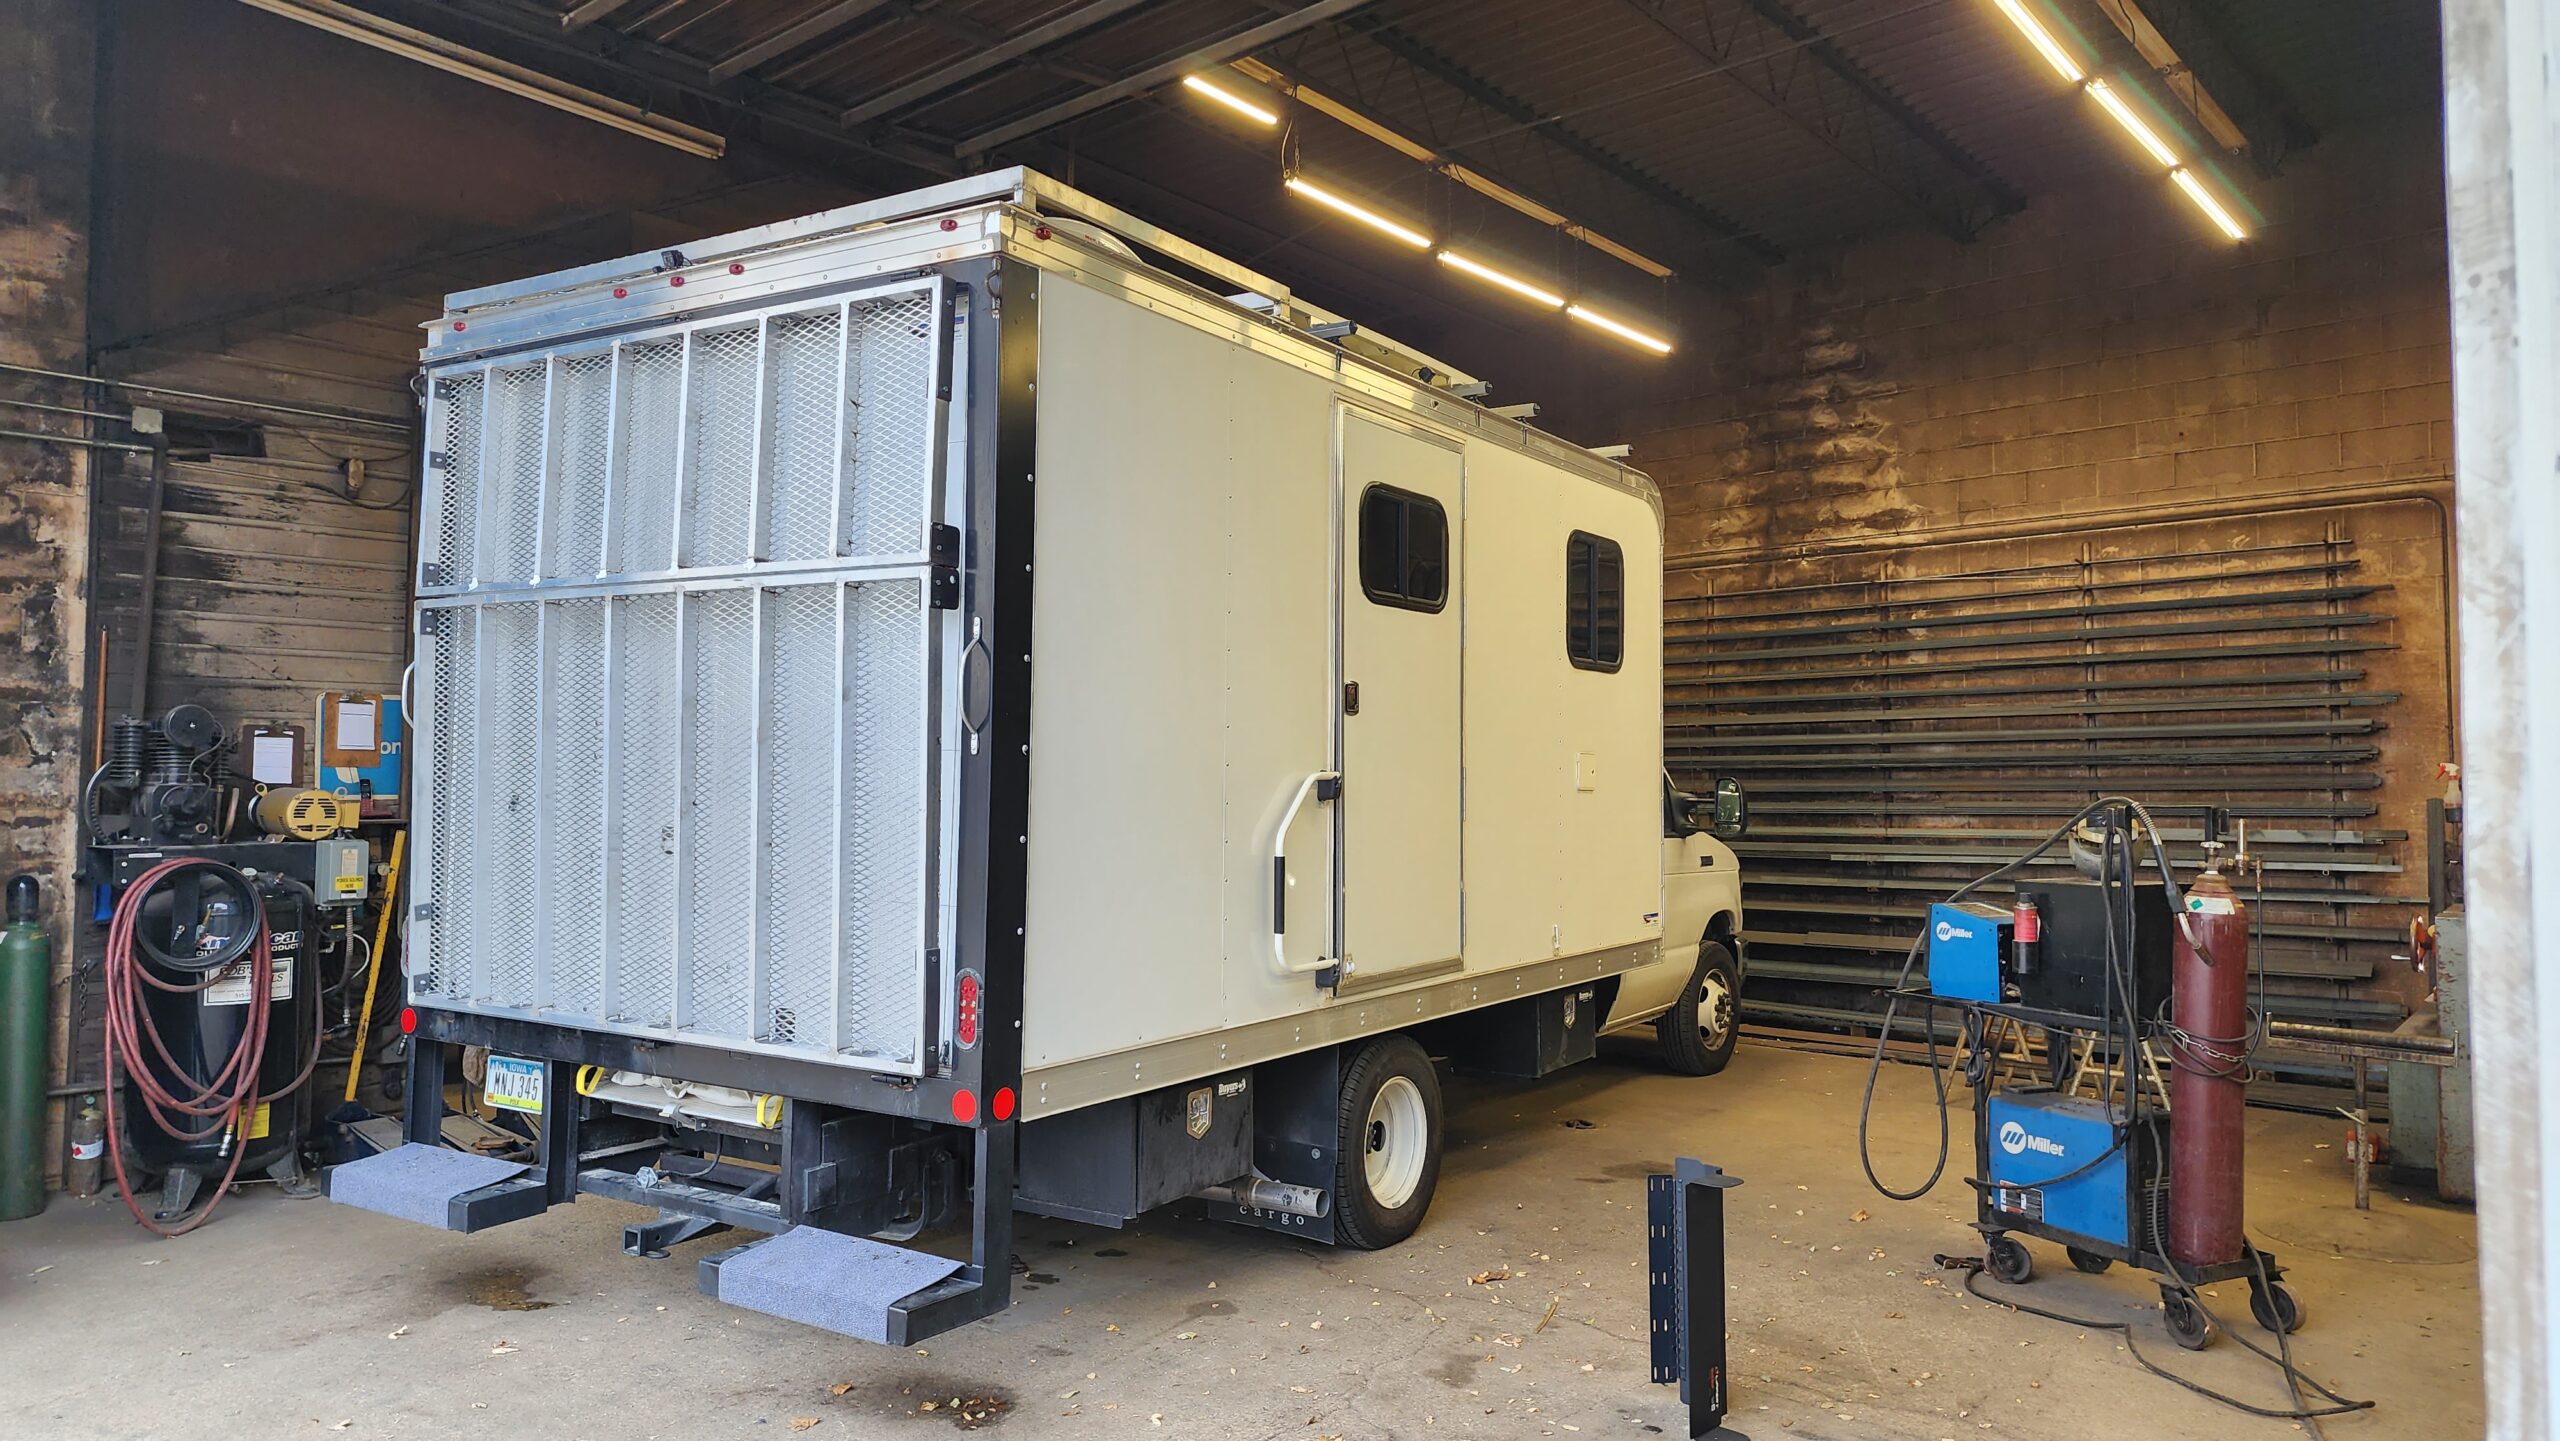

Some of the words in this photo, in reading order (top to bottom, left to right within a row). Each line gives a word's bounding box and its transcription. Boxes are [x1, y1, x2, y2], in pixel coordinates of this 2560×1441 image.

[1951, 927, 1973, 939] Miller
[509, 1062, 528, 1074] IOWA
[517, 1075, 540, 1101] 345
[2027, 1134, 2064, 1157] Miller
[1239, 1205, 1305, 1225] cargo
